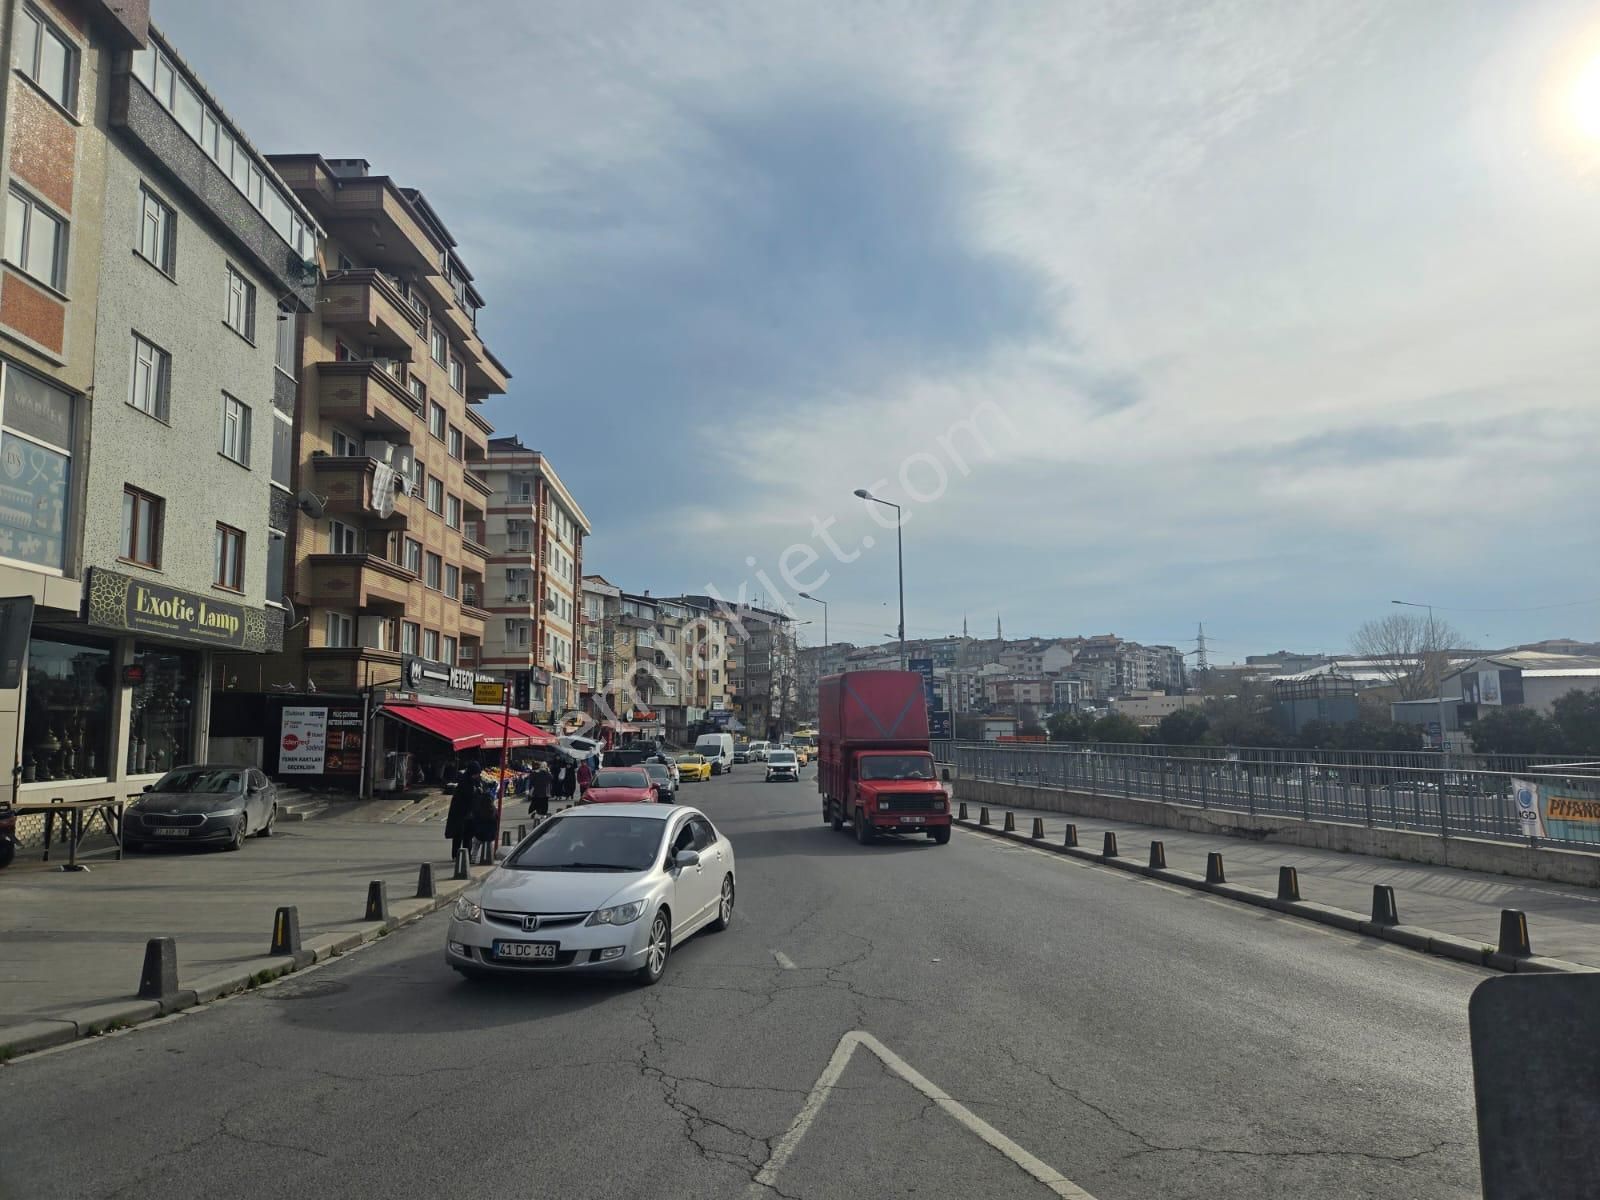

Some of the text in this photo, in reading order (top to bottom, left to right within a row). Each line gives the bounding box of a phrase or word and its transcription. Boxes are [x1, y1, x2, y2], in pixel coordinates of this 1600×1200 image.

[134, 586, 239, 638] Exotic Lamp
[450, 667, 474, 693] METEOR
[500, 943, 554, 957] 41 DC 143
